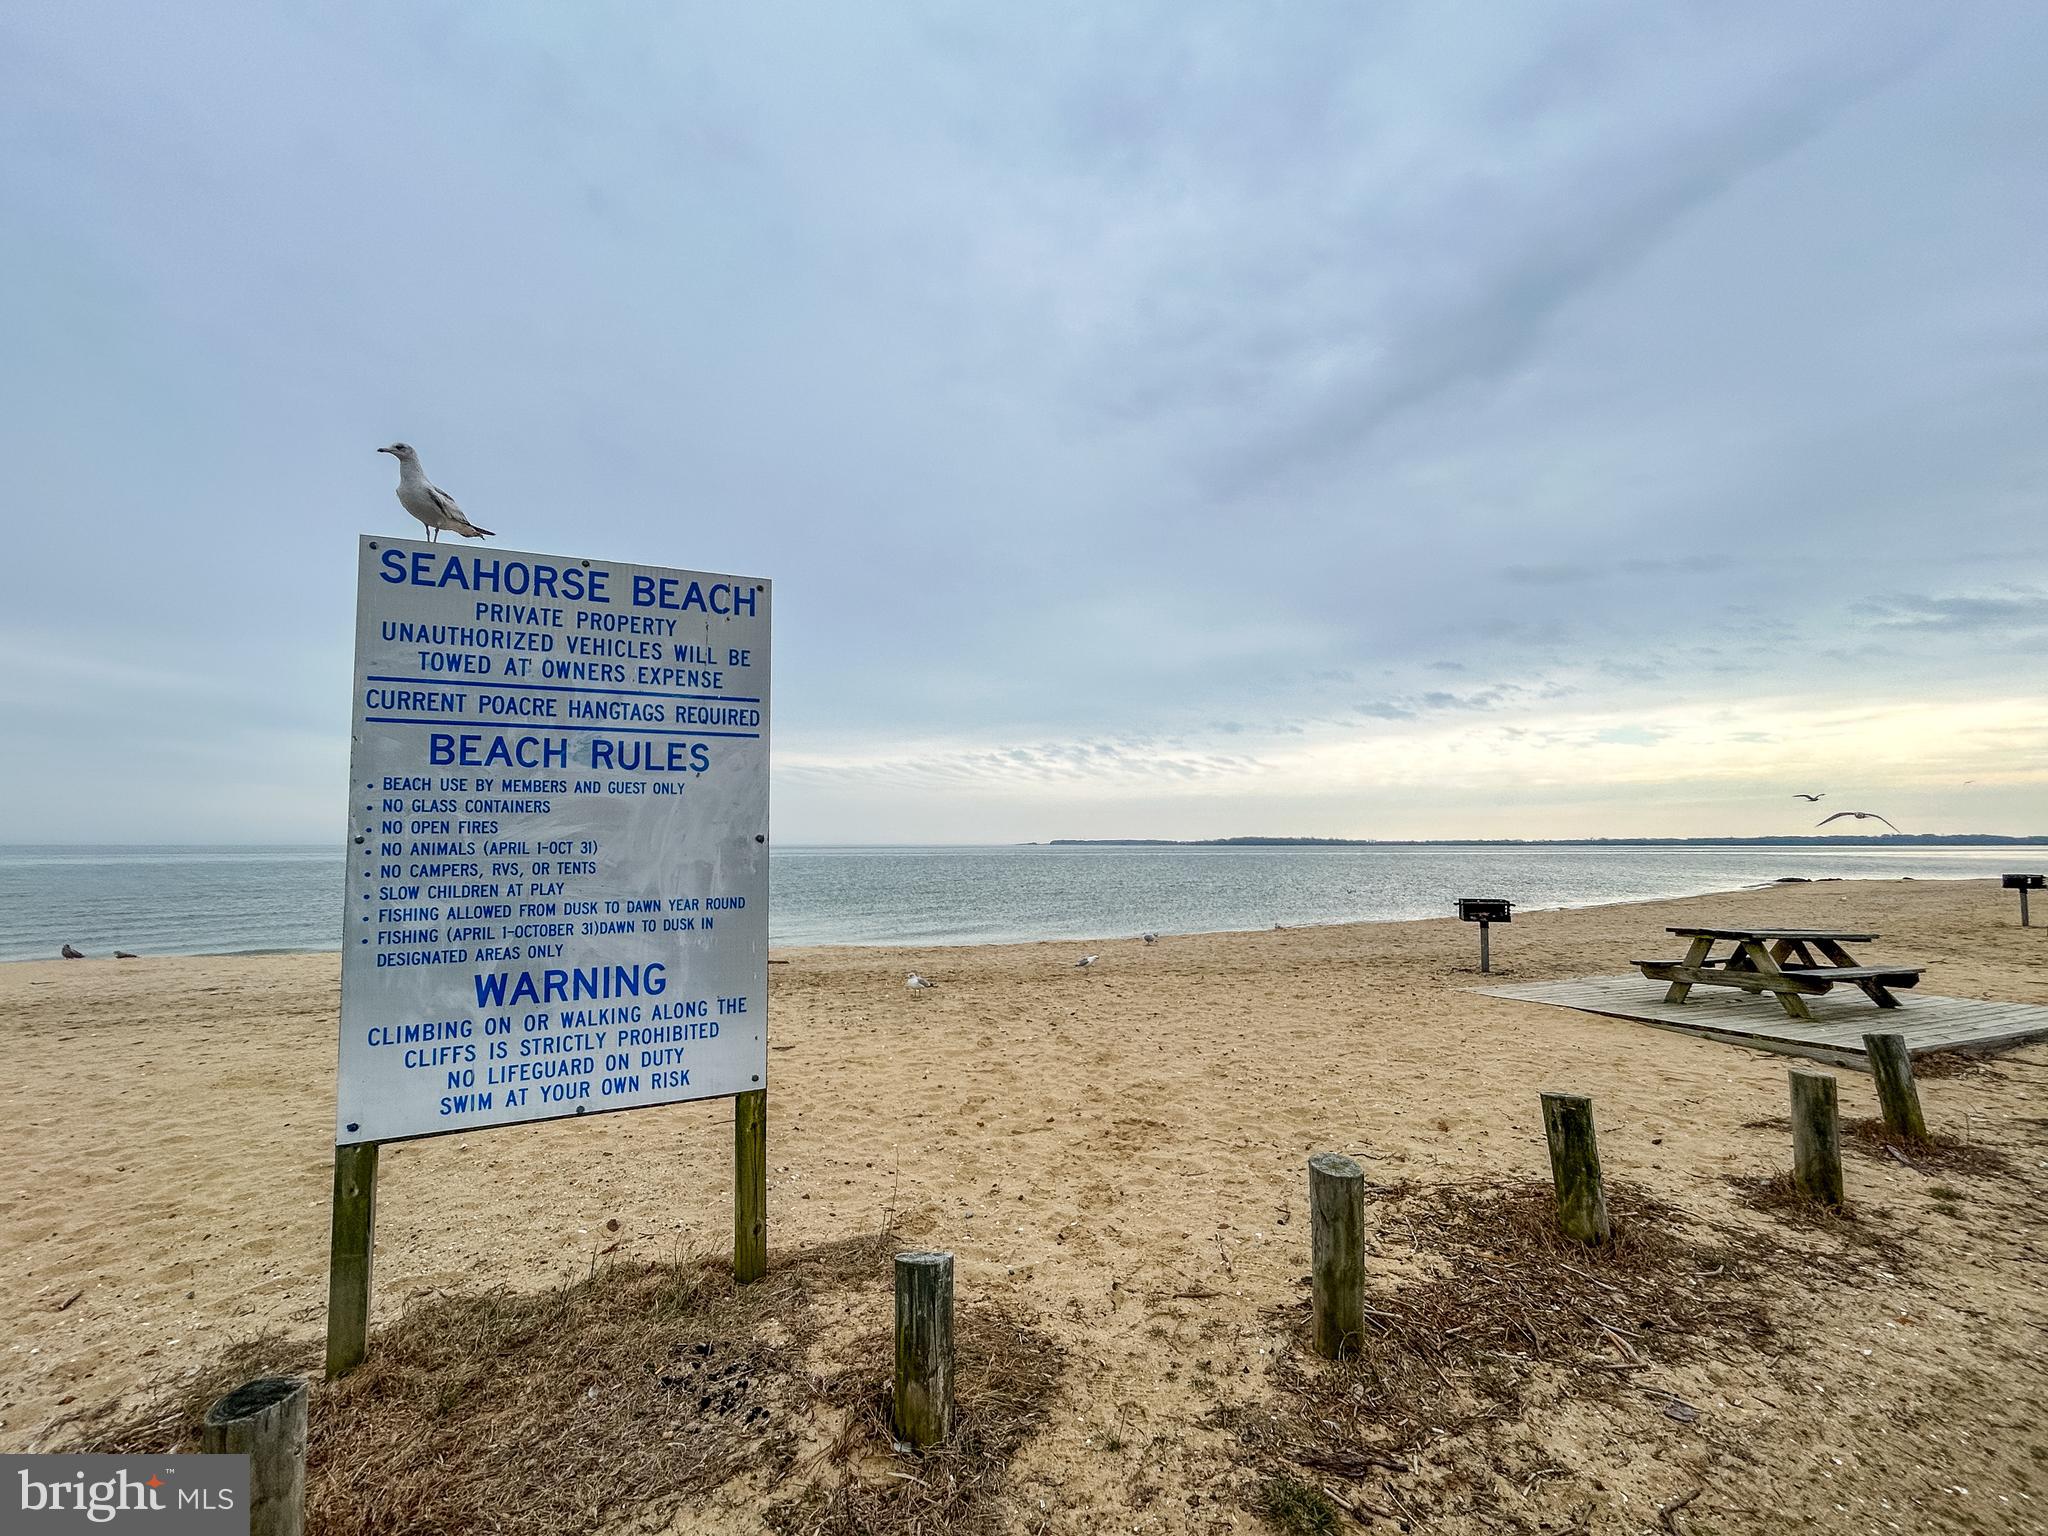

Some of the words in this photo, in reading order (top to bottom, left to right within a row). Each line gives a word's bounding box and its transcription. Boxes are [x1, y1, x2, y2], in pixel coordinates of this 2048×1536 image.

[380, 549, 610, 603] SEAHORSE
[633, 575, 756, 617] BEACH
[476, 603, 564, 628] PRIVATE
[577, 611, 677, 636] PROPERTY
[382, 621, 554, 652] UNAUTHORIZED
[566, 635, 662, 660] VEHICLES
[674, 644, 717, 665] WILL
[729, 649, 751, 667] BE
[418, 651, 491, 675] TOWED
[504, 658, 529, 676] AT
[542, 659, 625, 683] OWNERS
[638, 667, 724, 689] EXPENSE
[366, 689, 467, 713] CURRENT
[479, 695, 557, 717] POACRE
[569, 700, 665, 722] HANGTAGS
[676, 705, 760, 727] REQUIRED
[430, 733, 567, 768] BEACH
[592, 739, 710, 772] RULES
[383, 777, 432, 791] BEACH
[440, 778, 467, 792] USE
[476, 779, 493, 793] BY
[502, 779, 567, 794] MEMBERS
[574, 780, 601, 794] AND
[608, 782, 646, 794] GUEST
[653, 782, 685, 795] ONLY
[382, 799, 403, 813] NO
[412, 799, 458, 813] GLASS
[465, 799, 550, 814] CONTAINERS
[382, 820, 403, 835] NO
[410, 821, 450, 835] OPEN
[458, 820, 498, 834] FIRES
[381, 842, 402, 856] NO
[410, 842, 476, 856] ANIMALS
[483, 841, 529, 856] (APRIL
[579, 841, 598, 856] 31)
[380, 864, 401, 879] NO
[410, 863, 483, 879] CAMPERS,
[492, 862, 524, 878] RVS,
[532, 862, 550, 875] OR
[557, 861, 596, 875] TENTS
[379, 886, 419, 901] SLOW
[428, 884, 499, 899] CHILDREN
[507, 884, 523, 897] AT
[531, 883, 565, 896] PLAY
[379, 907, 439, 922] FISHING
[447, 904, 511, 920] ALLOWED
[520, 902, 558, 917] FROM
[564, 901, 598, 916] DUSK
[605, 900, 620, 914] TO
[627, 899, 661, 913] DAWN
[669, 897, 699, 911] YEAR
[706, 897, 746, 910] ROUND
[378, 929, 439, 945] FISHING
[447, 926, 495, 942] (APRIL
[642, 919, 657, 932] TO
[664, 917, 695, 931] DUSK
[701, 917, 714, 930] IN
[377, 950, 468, 967] DESIGNATED
[475, 947, 520, 962] AREAS
[528, 944, 564, 959] ONLY
[474, 962, 667, 1009] WARNING
[368, 1019, 473, 1046] CLIMBING
[485, 1017, 511, 1035] ON
[524, 1014, 549, 1031] OR
[560, 1006, 641, 1029] WALKING
[651, 1001, 708, 1021] ALONG
[717, 997, 747, 1014] THE
[404, 1045, 476, 1068] CLIFFS
[490, 1041, 508, 1060] IS
[520, 1032, 607, 1056] STRICTLY
[618, 1022, 720, 1046] PROHIBITED
[447, 1069, 474, 1089] NO
[488, 1059, 595, 1085] LIFEGUARD
[606, 1054, 629, 1071] ON
[641, 1049, 685, 1068] DUTY
[440, 1093, 493, 1116] SWIM
[505, 1089, 527, 1108] AT
[540, 1082, 590, 1102] YOUR
[601, 1077, 639, 1095] OWN
[651, 1070, 690, 1089] RISK
